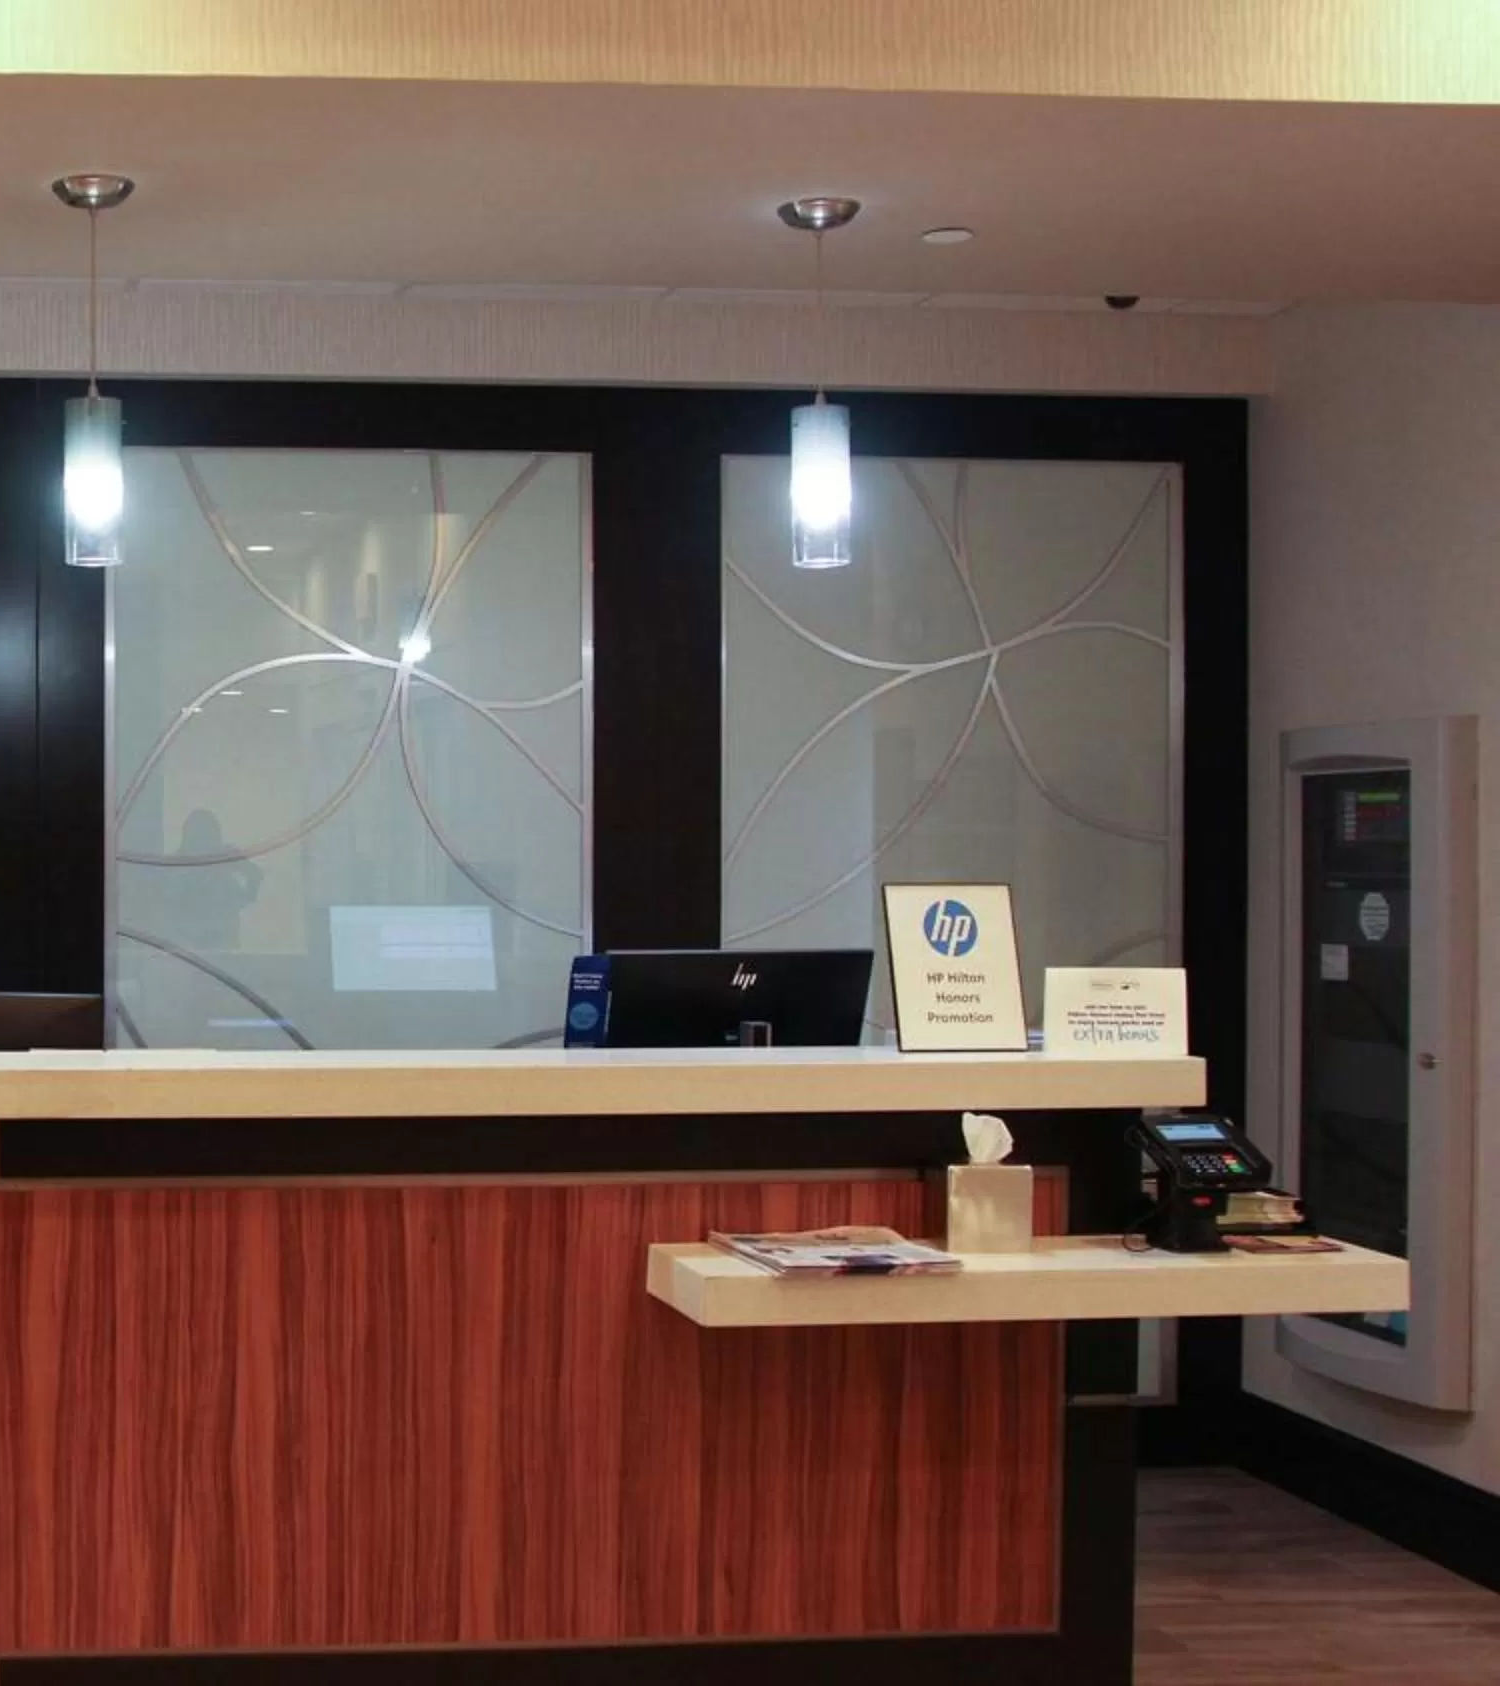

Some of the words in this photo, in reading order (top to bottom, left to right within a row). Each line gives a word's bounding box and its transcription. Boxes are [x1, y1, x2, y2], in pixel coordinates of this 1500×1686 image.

[929, 899, 972, 957] hp
[731, 963, 757, 990] hp
[927, 971, 945, 985] HP
[947, 971, 986, 985] Hilton
[935, 991, 981, 1004] Honors
[927, 1011, 993, 1024] Promotion
